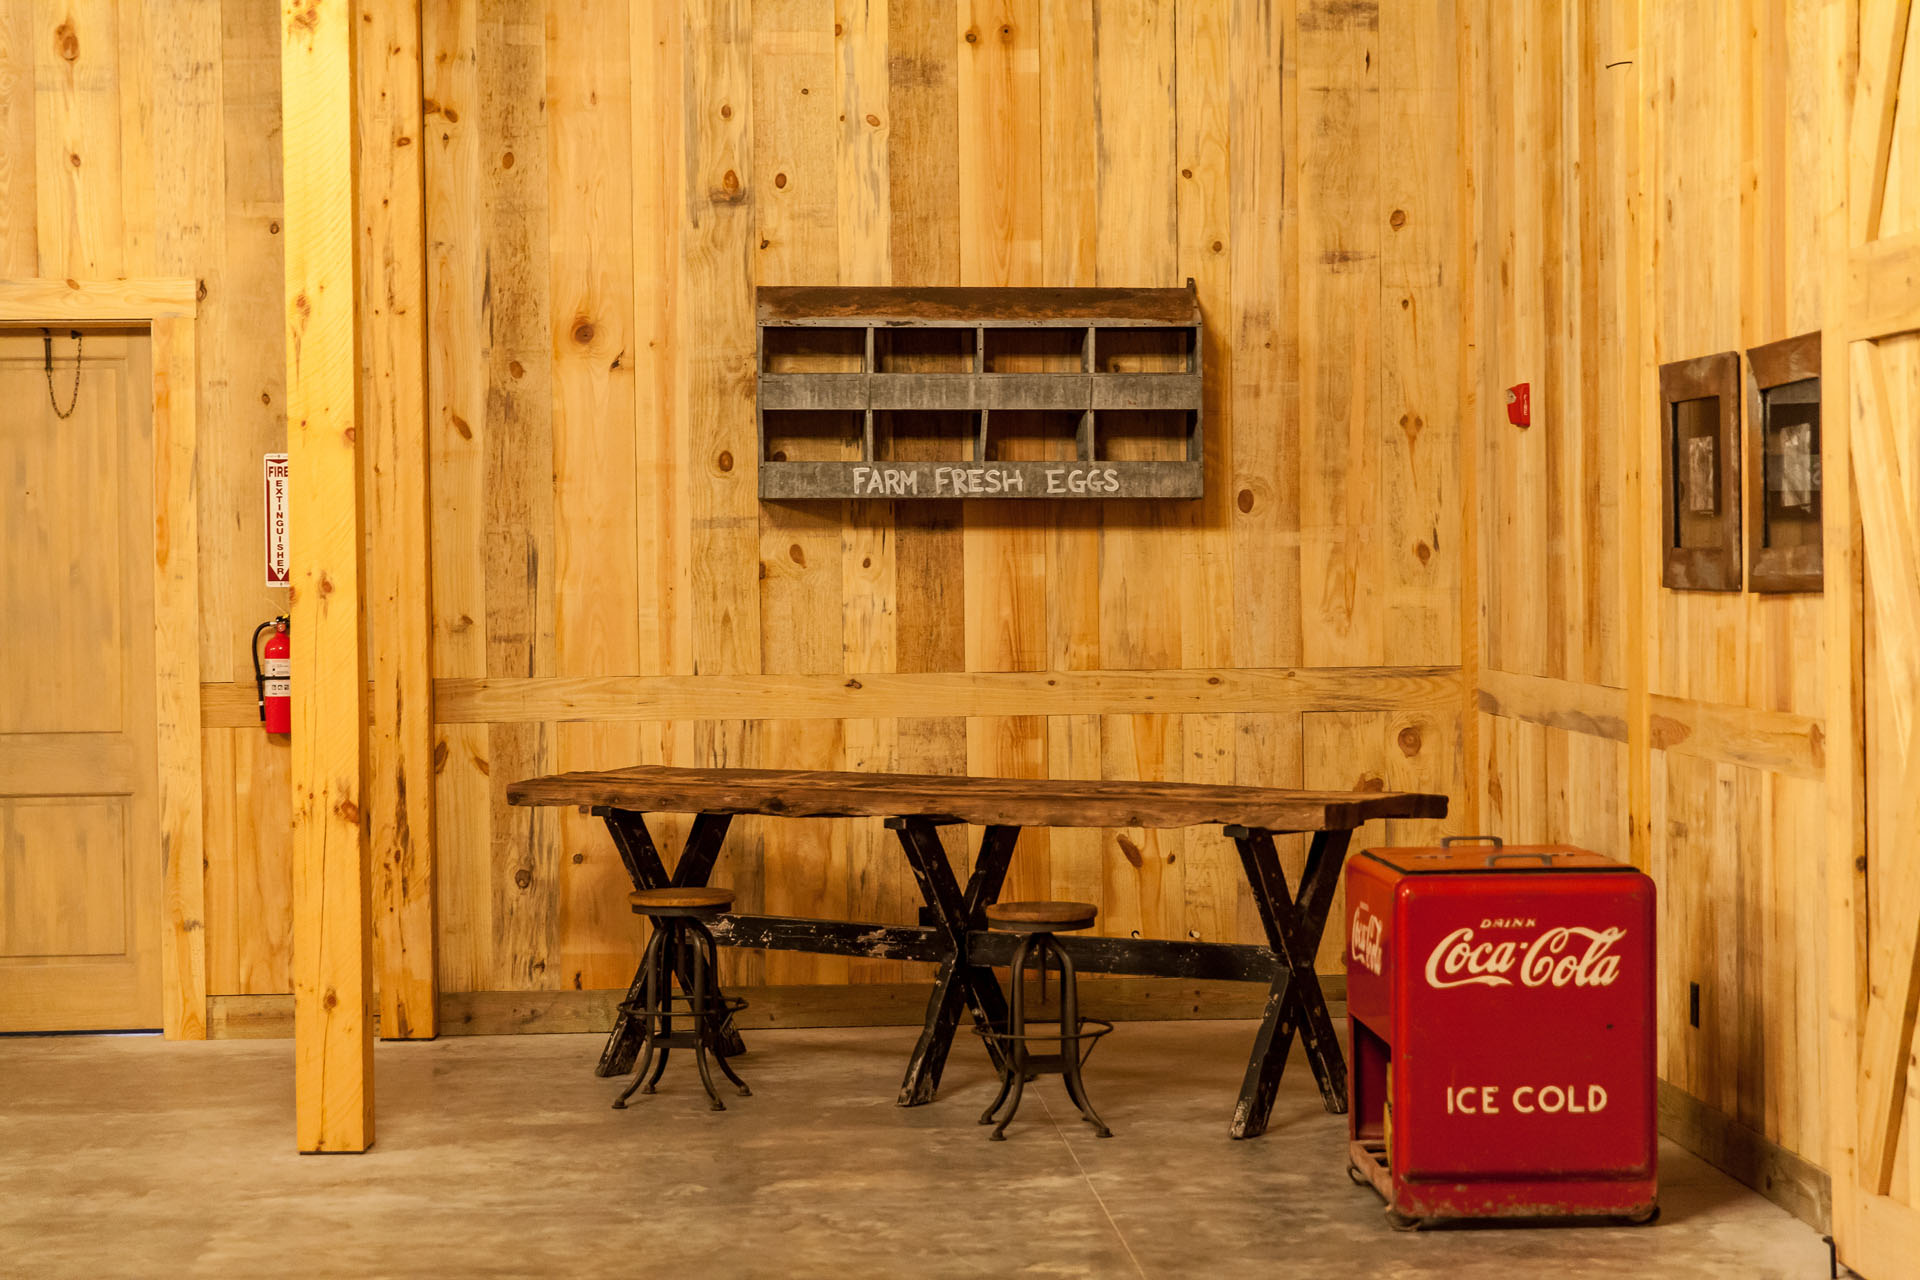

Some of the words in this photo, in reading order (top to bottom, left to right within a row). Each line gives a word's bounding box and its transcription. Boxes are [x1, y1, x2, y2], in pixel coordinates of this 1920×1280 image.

[268, 466, 288, 477] FIRE
[853, 467, 918, 494] FARM
[935, 467, 1024, 495] FRESH
[1045, 469, 1120, 493] EGGS
[275, 480, 284, 574] EXTINGUISHER
[1479, 918, 1537, 928] DRINK
[1425, 926, 1627, 988] Coca-Cola
[1447, 1086, 1500, 1114] ICE
[1512, 1085, 1608, 1114] COLD
